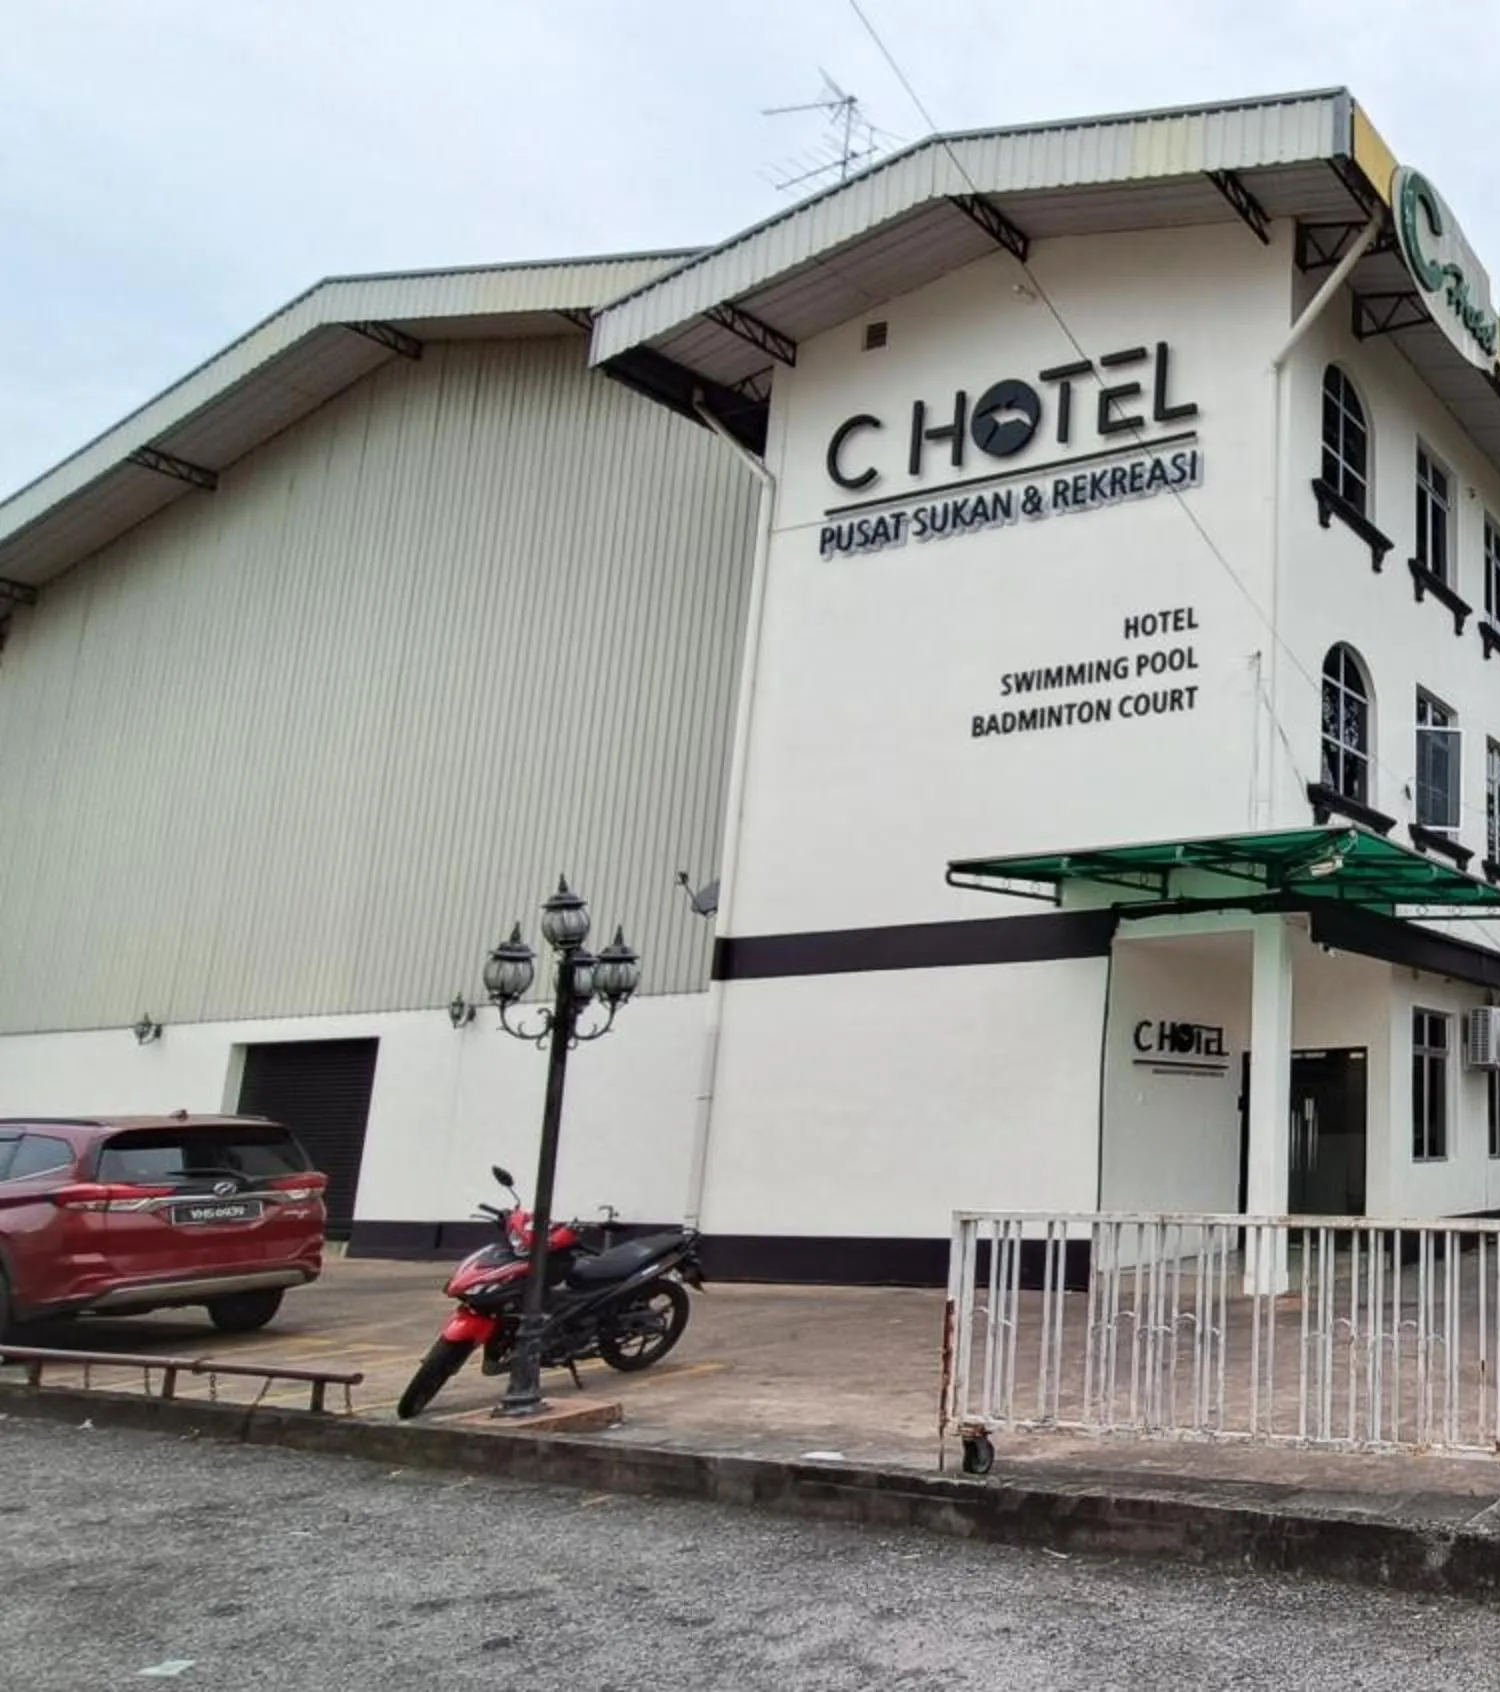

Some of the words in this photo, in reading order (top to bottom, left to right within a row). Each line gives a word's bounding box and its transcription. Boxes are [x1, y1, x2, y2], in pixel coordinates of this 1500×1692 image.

[826, 413, 882, 490] C
[908, 341, 1199, 476] HOTEL
[819, 513, 906, 557] PUSAT
[912, 490, 1013, 538] SUKAN
[1023, 485, 1044, 516] &
[1052, 450, 1200, 511] REKREASI
[1123, 607, 1199, 640] HOTEL
[1000, 657, 1130, 697] SWIMMING
[1136, 647, 1199, 678] POOL
[970, 700, 1112, 739] BADMINTON
[1118, 686, 1199, 719] COURT
[1134, 1020, 1153, 1051] C
[1159, 1021, 1230, 1057] HOTEL
